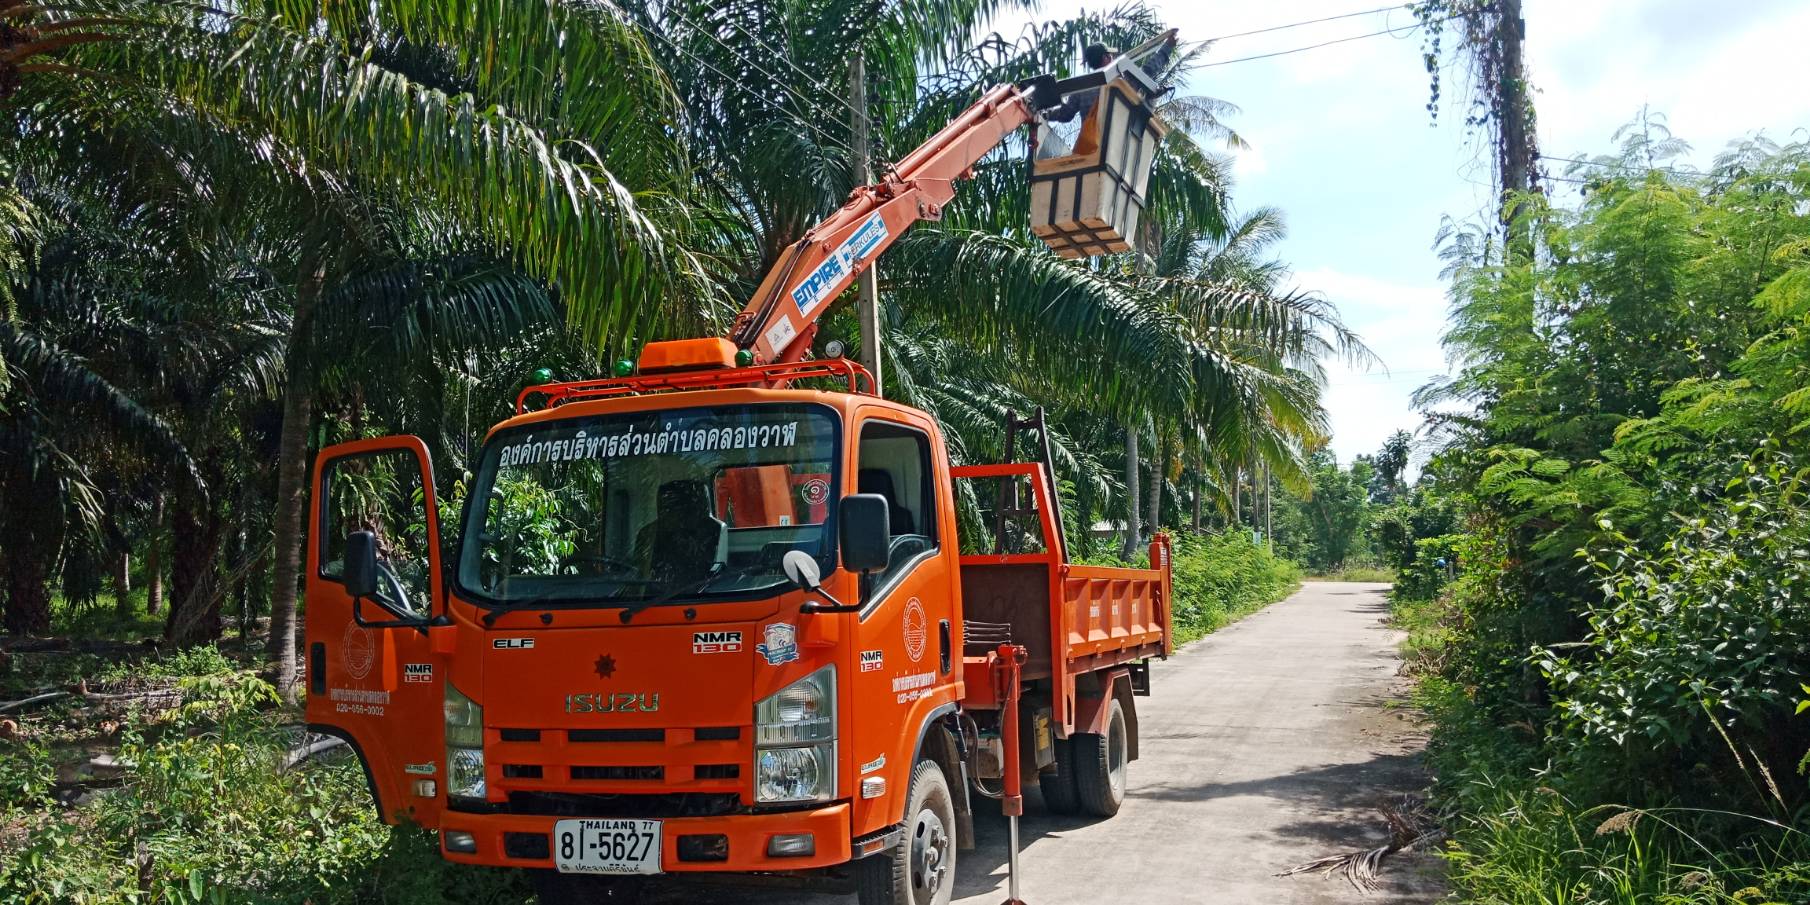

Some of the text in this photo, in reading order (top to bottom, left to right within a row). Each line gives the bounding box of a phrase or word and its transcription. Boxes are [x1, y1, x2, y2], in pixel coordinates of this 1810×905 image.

[849, 224, 880, 257] HERKULES
[792, 254, 841, 306] EMPIRE
[500, 421, 798, 466] องค์การบริหารส่วนตำบลคลองวาฬ
[693, 632, 742, 643] NMR
[493, 639, 535, 648] ELF
[693, 644, 742, 653] 130
[861, 651, 882, 661] NMR
[404, 665, 432, 673] NMR
[861, 662, 882, 671] 130
[565, 693, 659, 712] ISUZU
[579, 820, 654, 830] THAILAND 77
[561, 832, 654, 861] 81-5627
